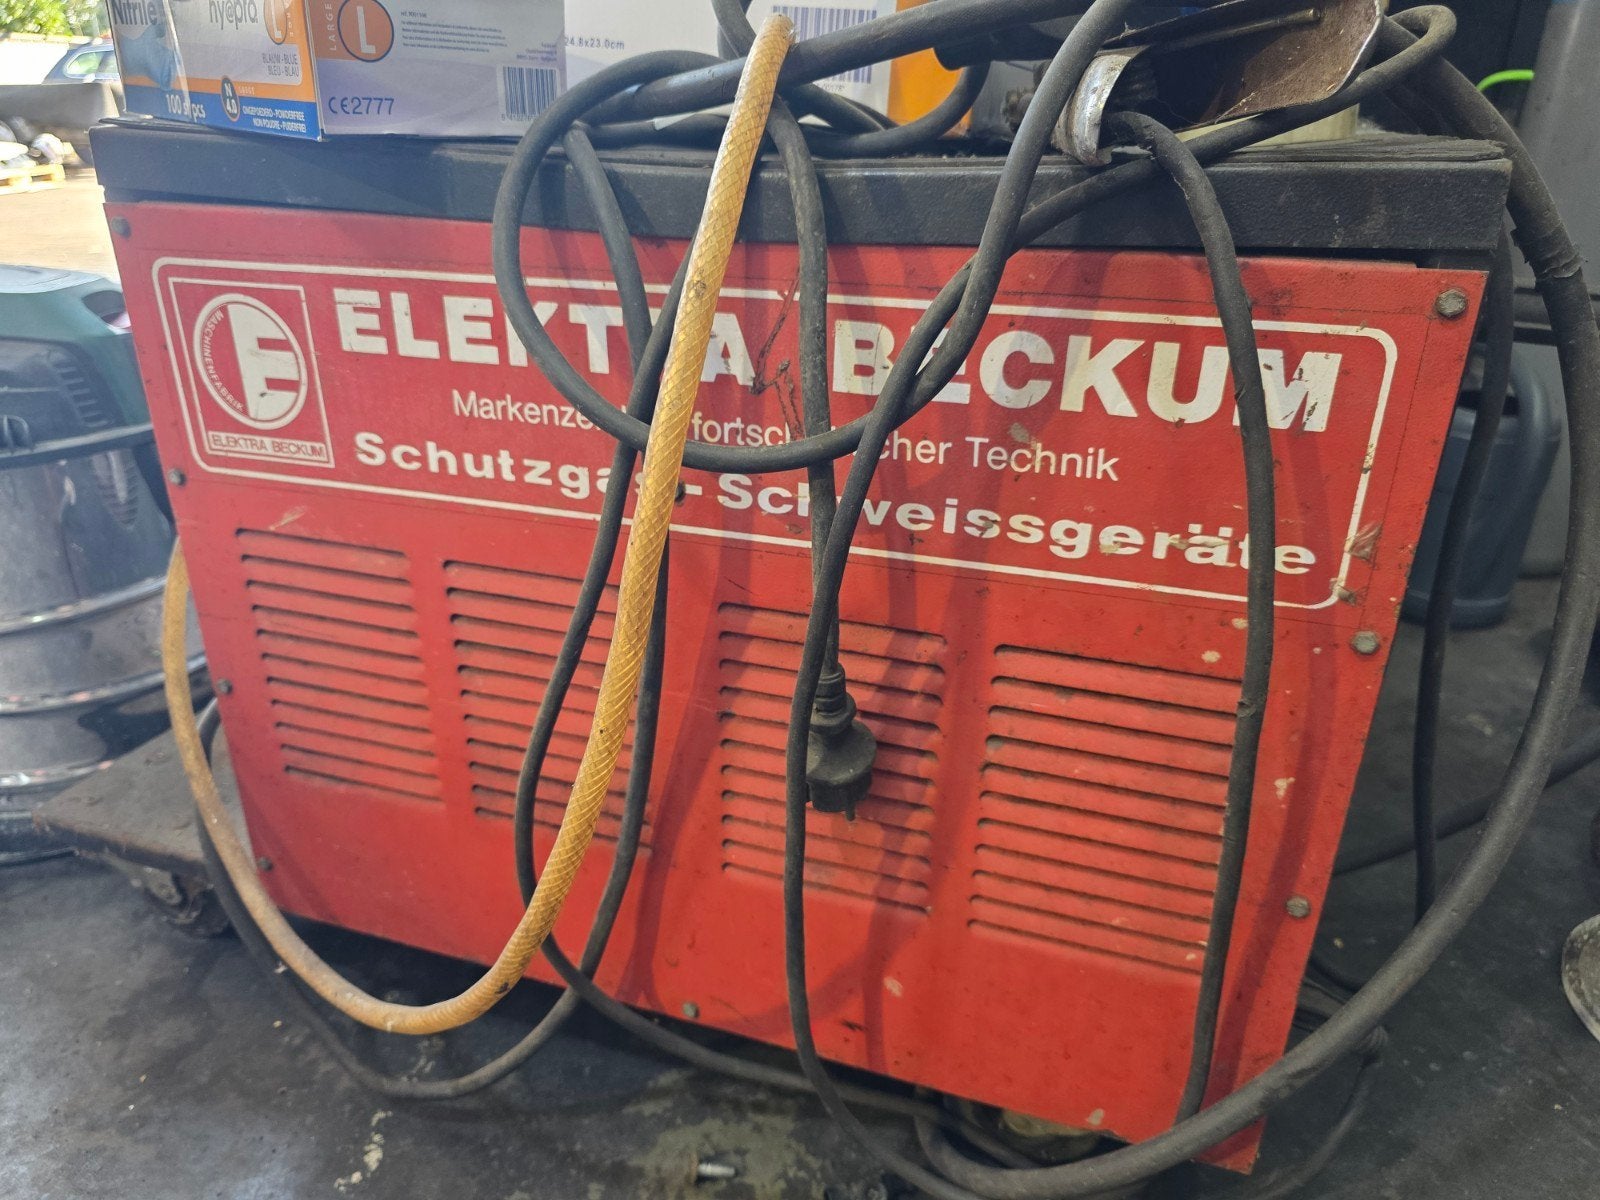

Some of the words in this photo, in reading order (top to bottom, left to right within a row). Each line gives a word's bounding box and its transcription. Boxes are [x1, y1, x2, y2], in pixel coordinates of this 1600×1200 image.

[113, 0, 159, 25] Nitrile
[324, 3, 337, 51] LARGE
[356, 6, 376, 54] L
[166, 94, 182, 114] 100
[202, 309, 245, 411] MASCHINENFABRIK
[333, 288, 755, 387] ELETA
[210, 433, 267, 450] ELEKTRA
[271, 441, 325, 458] BECKUM
[965, 436, 1120, 482] Technik
